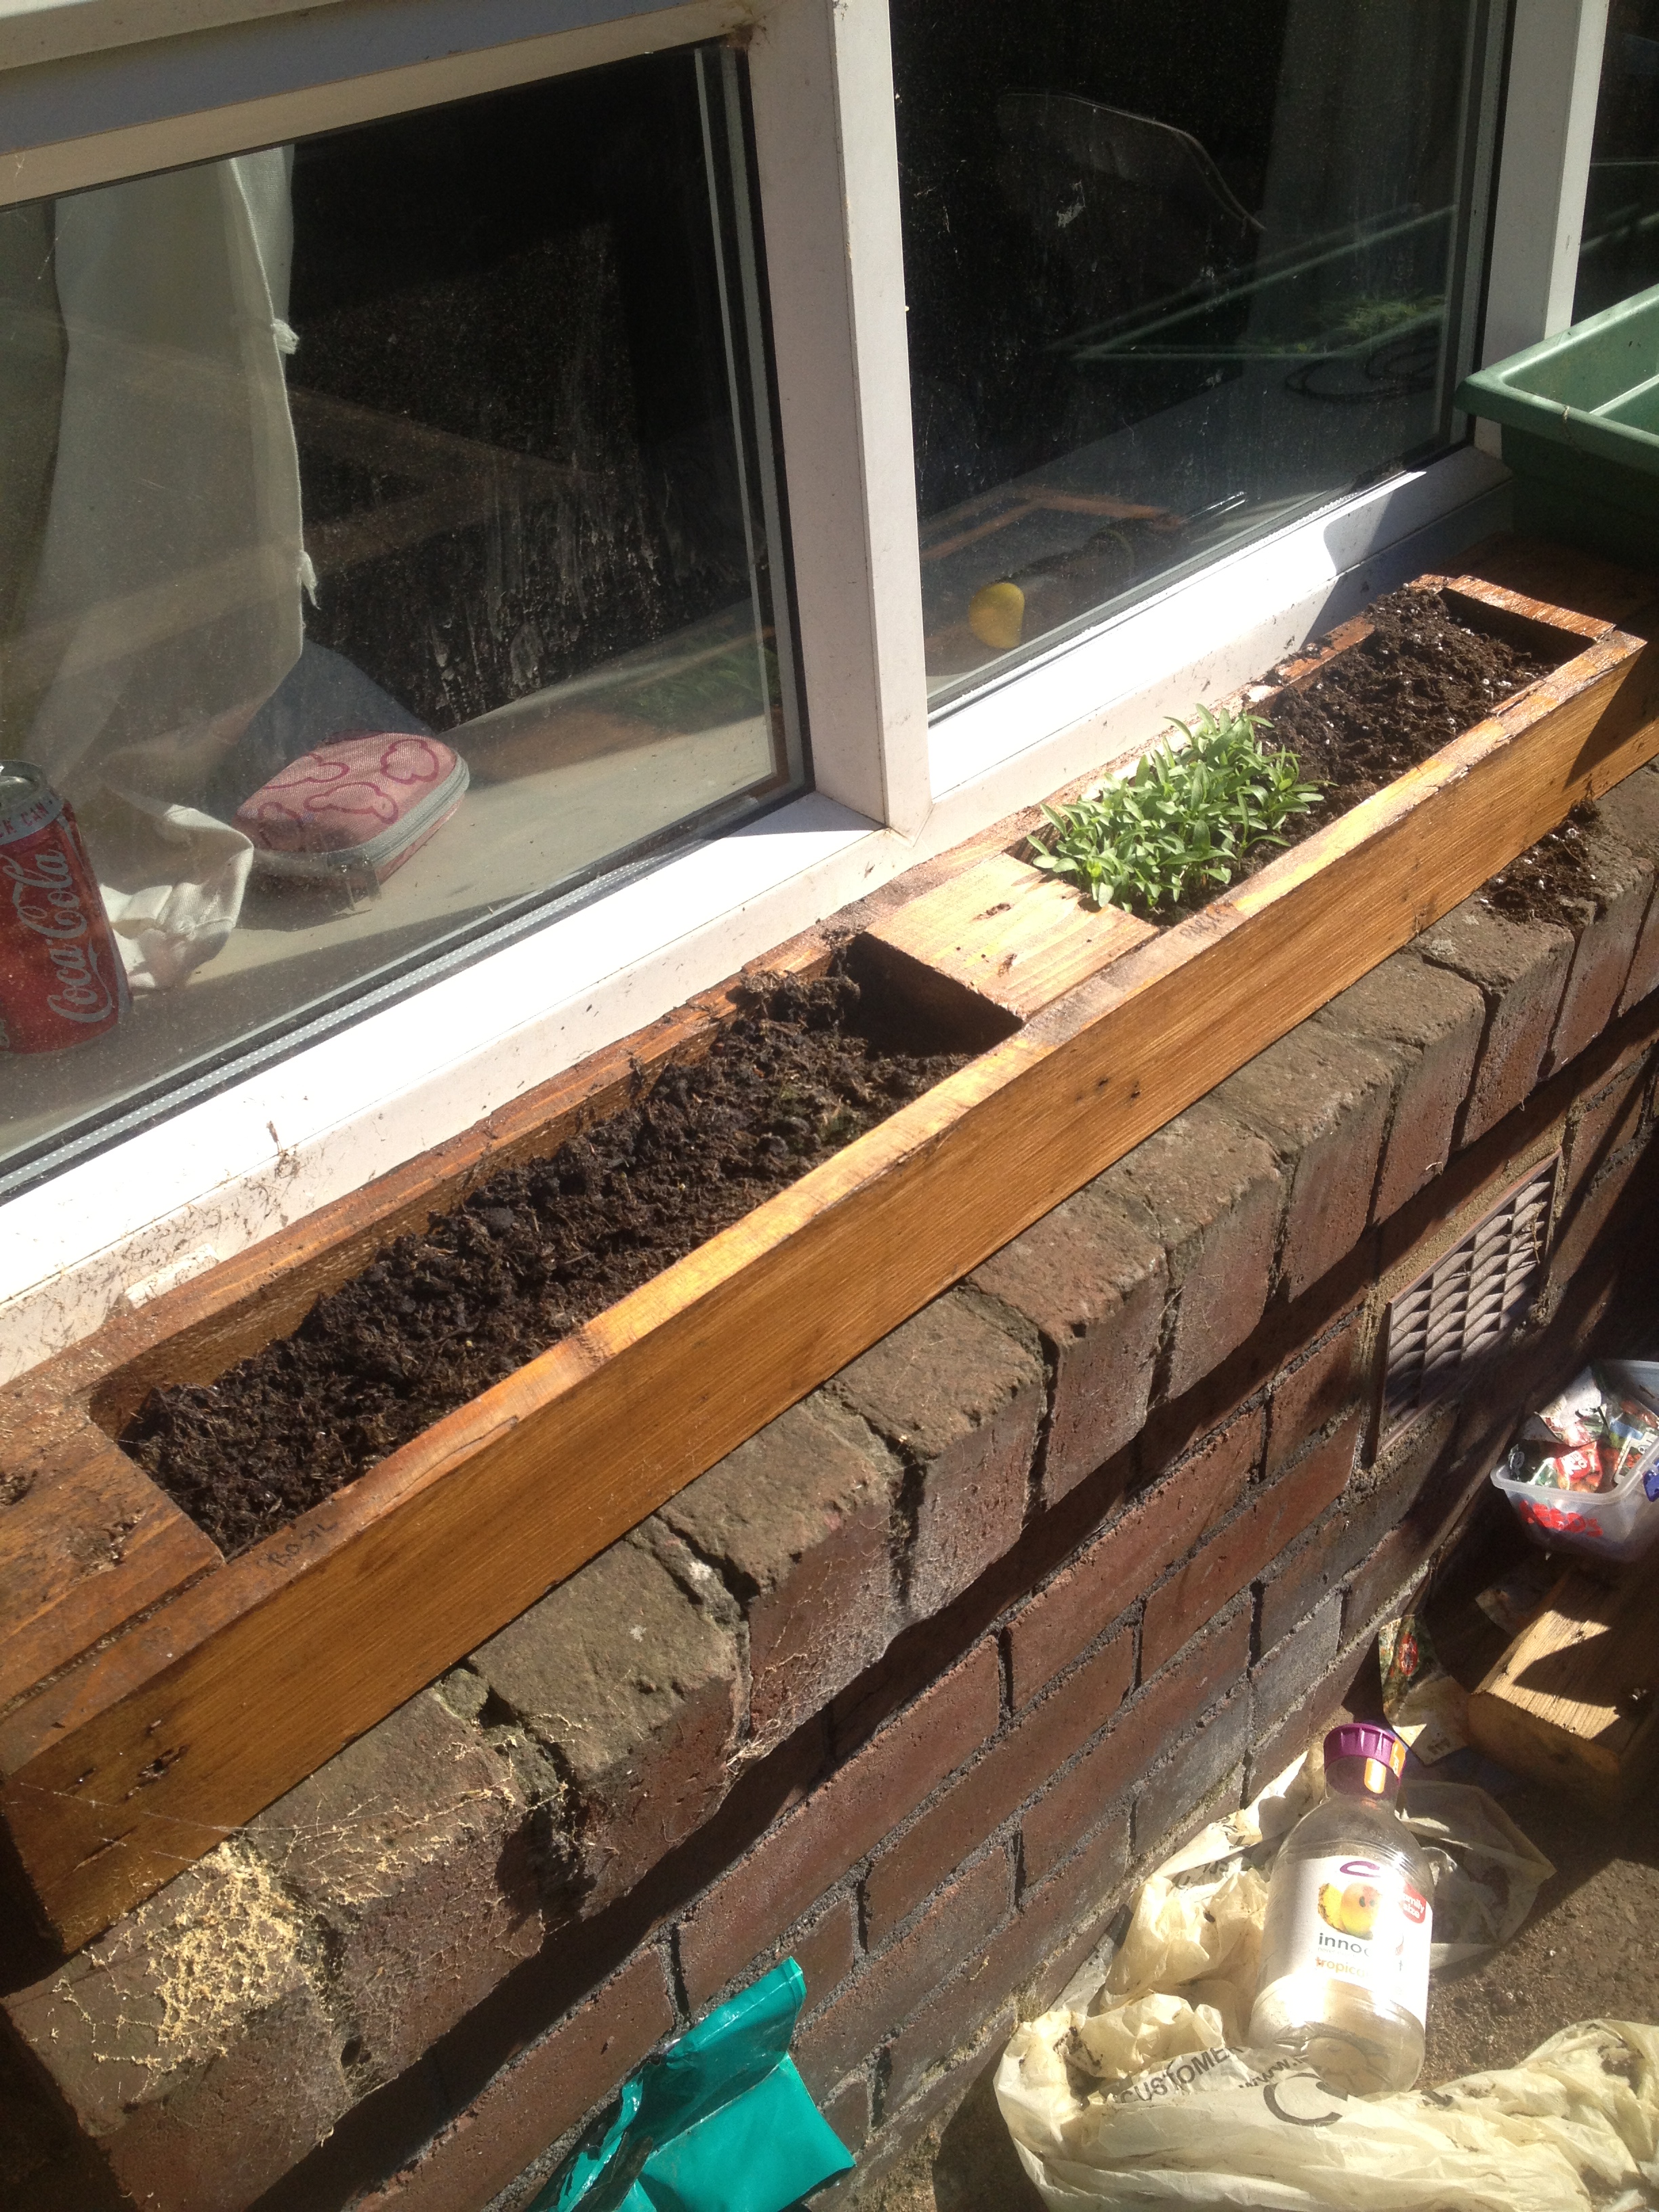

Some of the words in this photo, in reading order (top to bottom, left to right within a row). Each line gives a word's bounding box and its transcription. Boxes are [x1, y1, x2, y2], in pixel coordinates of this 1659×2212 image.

[1, 848, 112, 1022] Coca-Cola
[1315, 1956, 1368, 1978] tropica
[1120, 2045, 1244, 2104] CUSTOME
